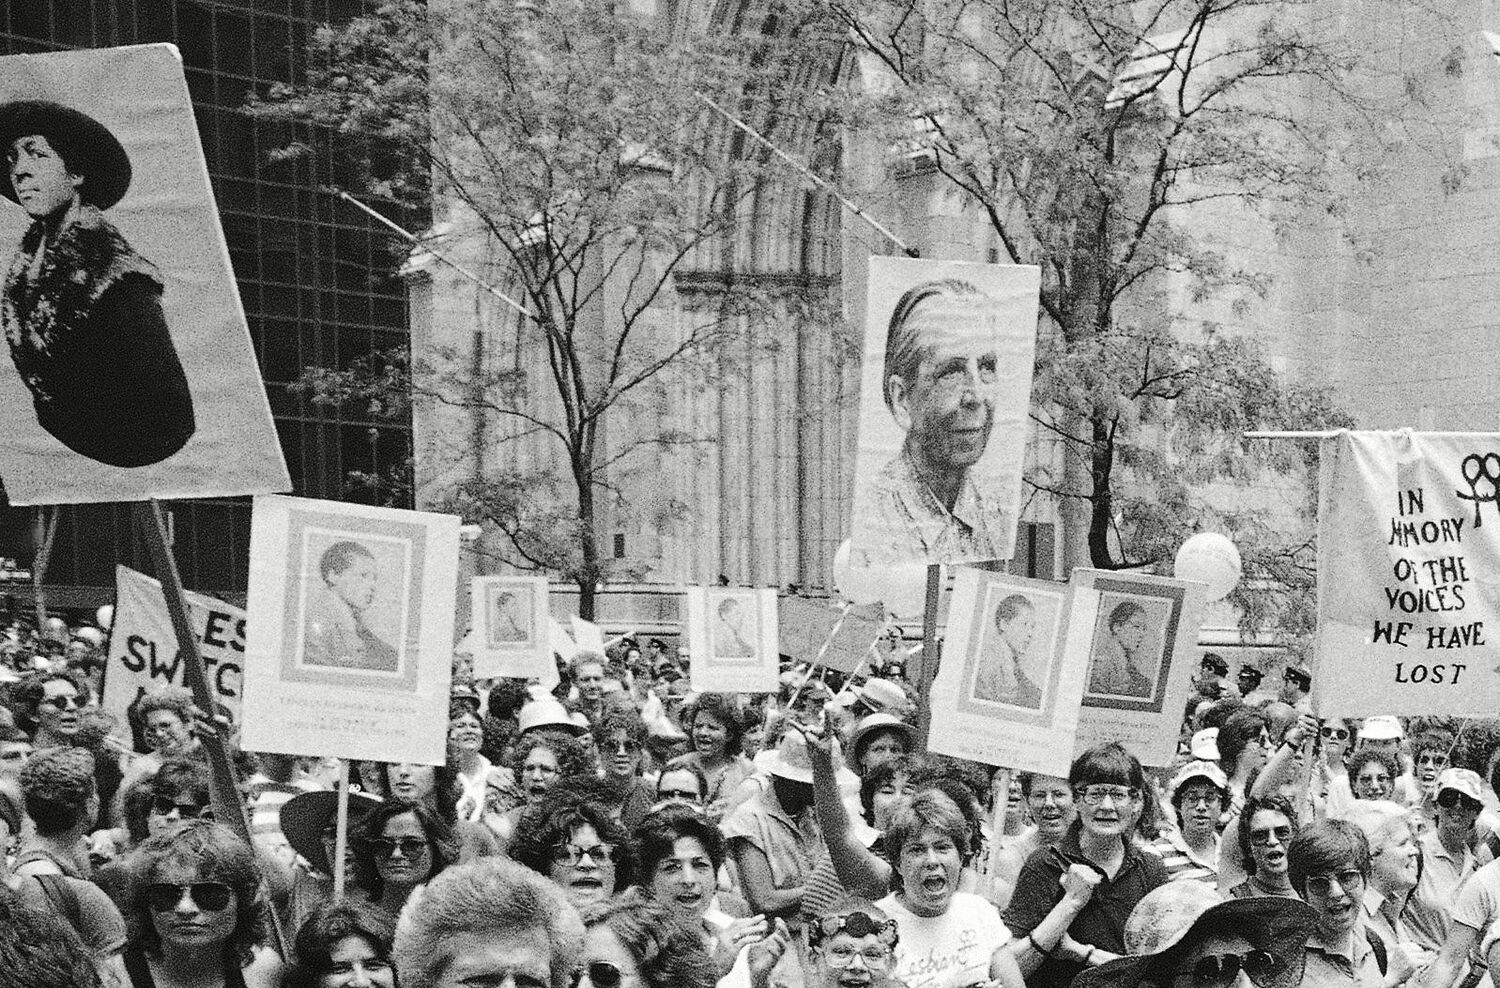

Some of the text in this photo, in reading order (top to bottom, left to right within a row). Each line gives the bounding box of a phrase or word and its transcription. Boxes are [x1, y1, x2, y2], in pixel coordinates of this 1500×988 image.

[1398, 487, 1424, 516] IN
[1423, 556, 1470, 586] THE
[1384, 584, 1466, 613] VOICES
[203, 610, 247, 653] ES
[1373, 620, 1486, 650] WE HAVE
[120, 634, 242, 697] SWTC
[1395, 662, 1467, 685] LOST
